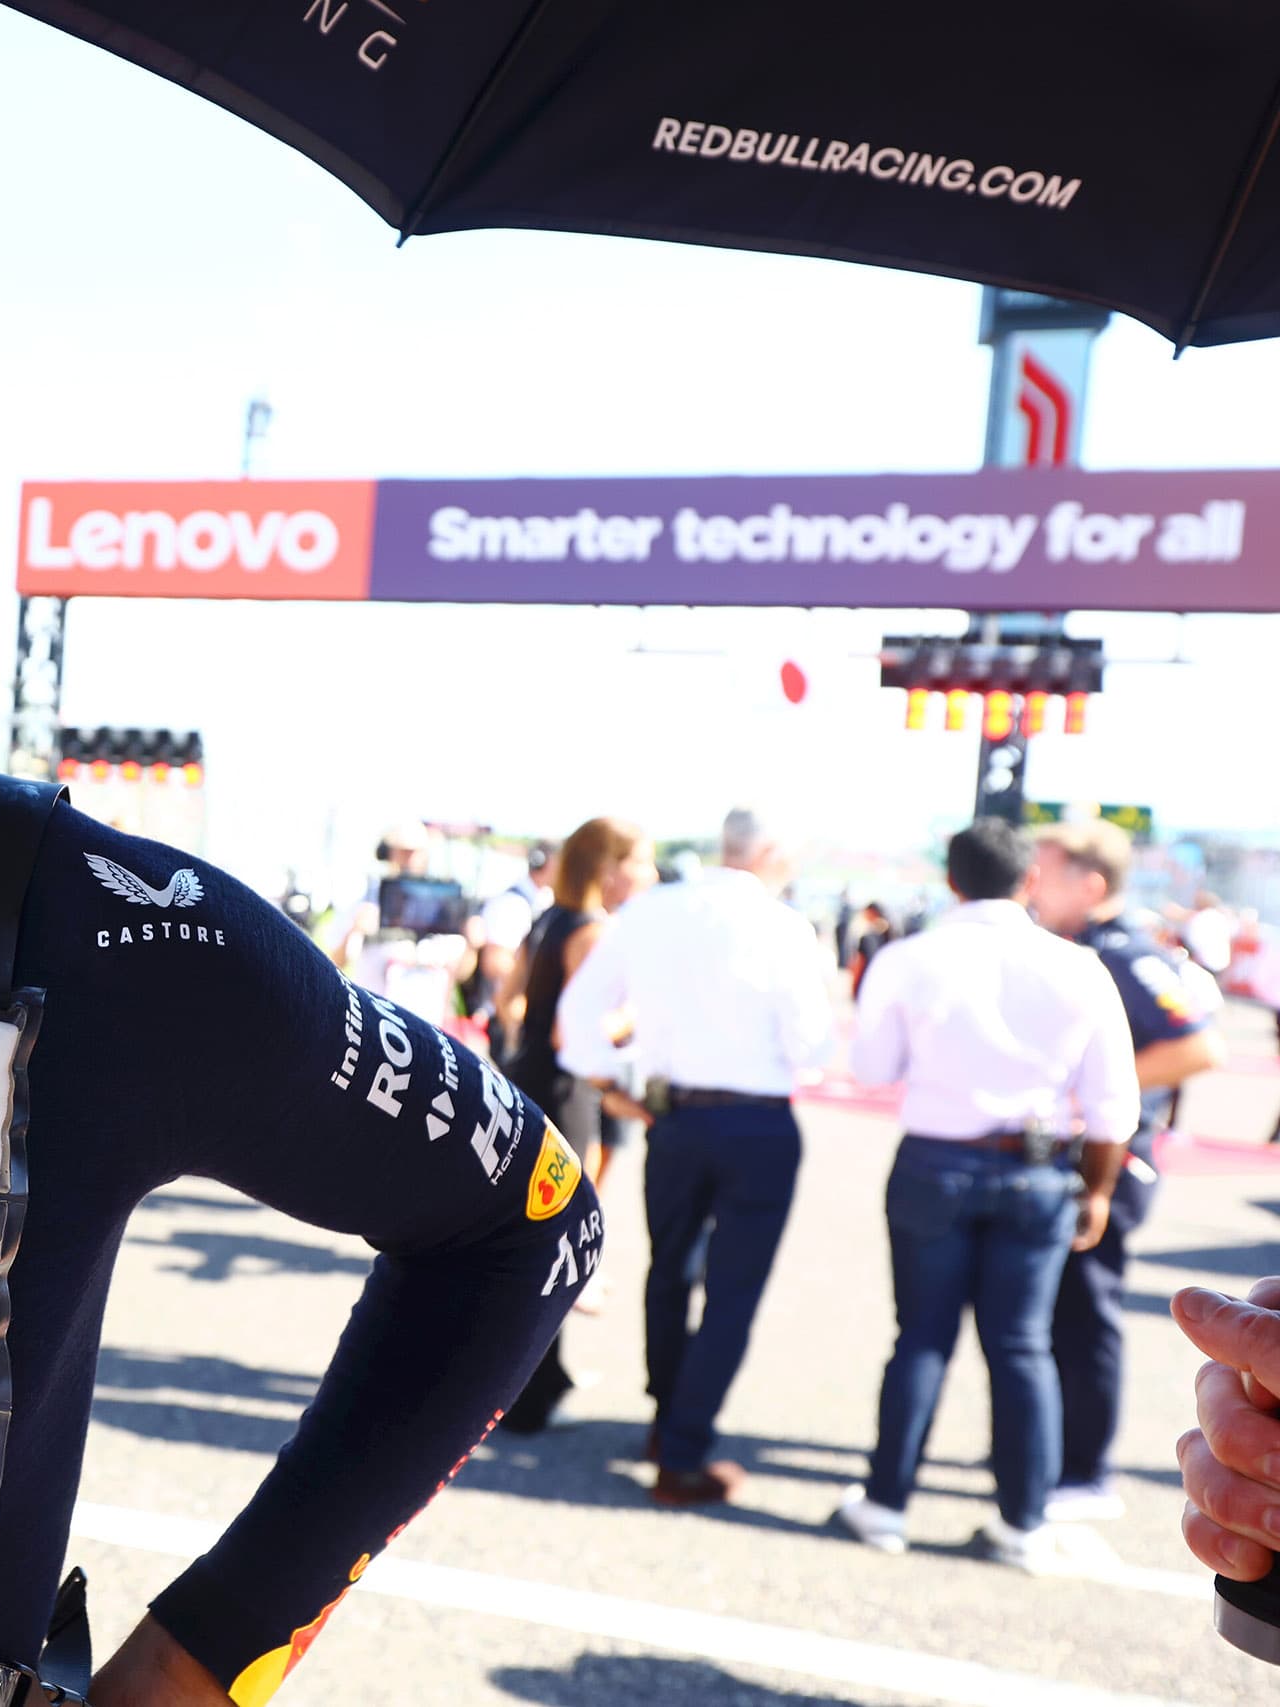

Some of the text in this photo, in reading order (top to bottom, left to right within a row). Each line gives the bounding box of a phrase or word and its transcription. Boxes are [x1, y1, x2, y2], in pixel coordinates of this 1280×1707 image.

[652, 117, 1082, 209] REDBULLRACING.COM
[26, 496, 339, 572] Lenovo
[429, 500, 1246, 572] Smarter technology for all
[97, 921, 225, 948] CASTORE
